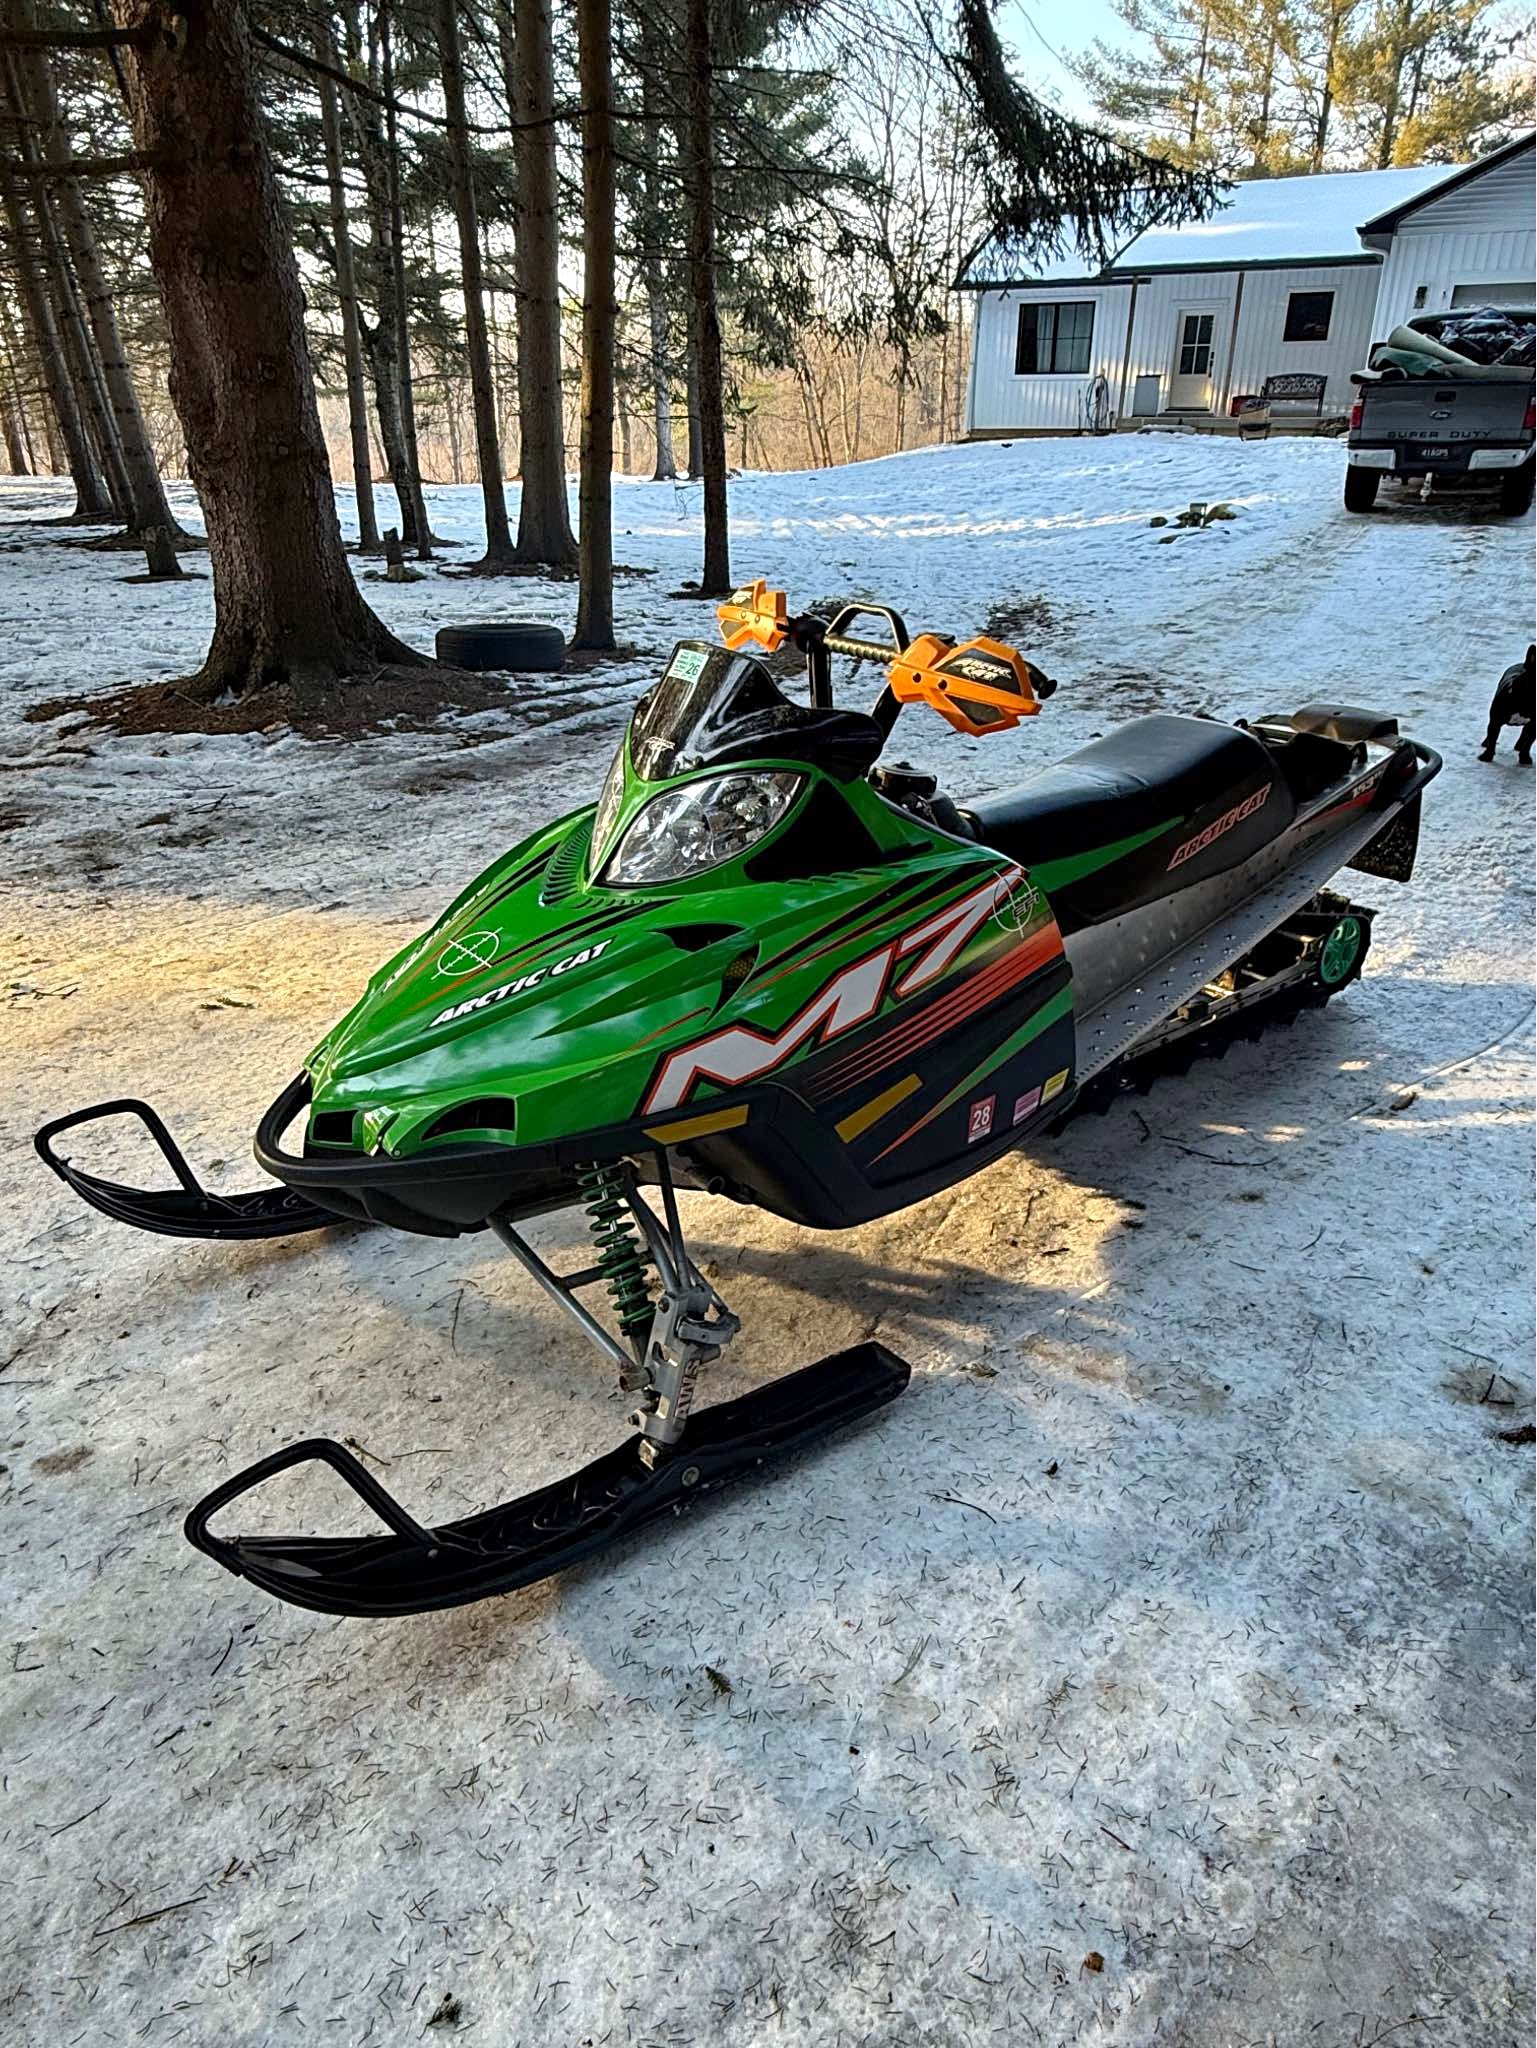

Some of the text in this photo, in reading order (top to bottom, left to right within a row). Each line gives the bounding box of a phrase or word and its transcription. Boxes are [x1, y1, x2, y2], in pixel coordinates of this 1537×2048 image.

[1387, 431, 1491, 439] SUPER DUTY
[685, 662, 700, 676] 26
[1166, 782, 1273, 872] ARCTIC CAT
[428, 938, 614, 1029] ARCTIC CAT
[640, 866, 1027, 1116] M7
[971, 1104, 991, 1132] 28
